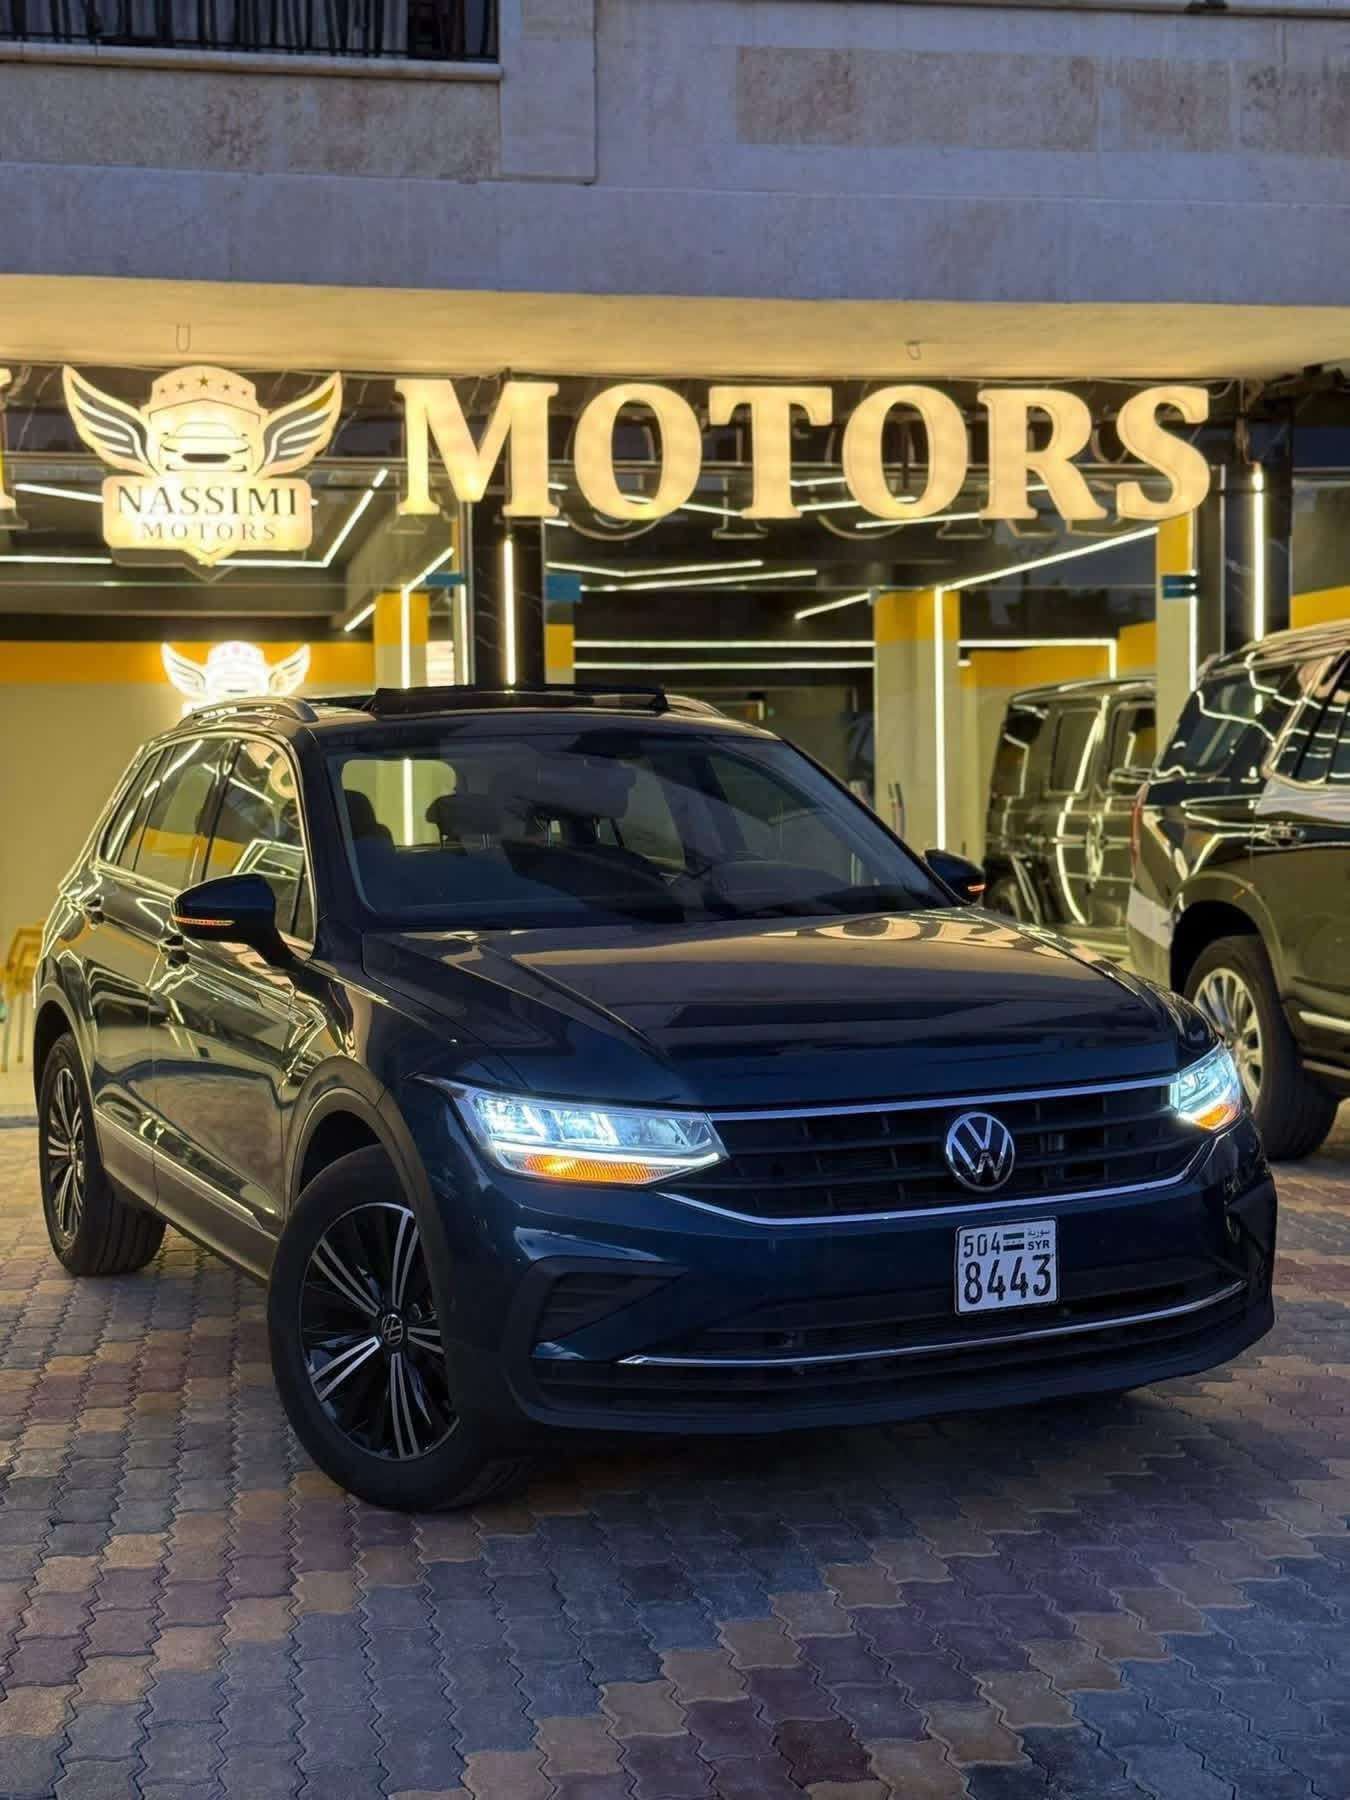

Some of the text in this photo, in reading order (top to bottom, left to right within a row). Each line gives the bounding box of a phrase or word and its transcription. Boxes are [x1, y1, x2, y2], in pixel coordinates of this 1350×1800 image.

[395, 378, 1211, 521] MOTORS
[116, 485, 298, 516] NASSIMI
[141, 521, 277, 540] MOTORS
[963, 1232, 1001, 1258] 504
[1027, 1239, 1050, 1251] SYR
[963, 1253, 1052, 1305] 8443
